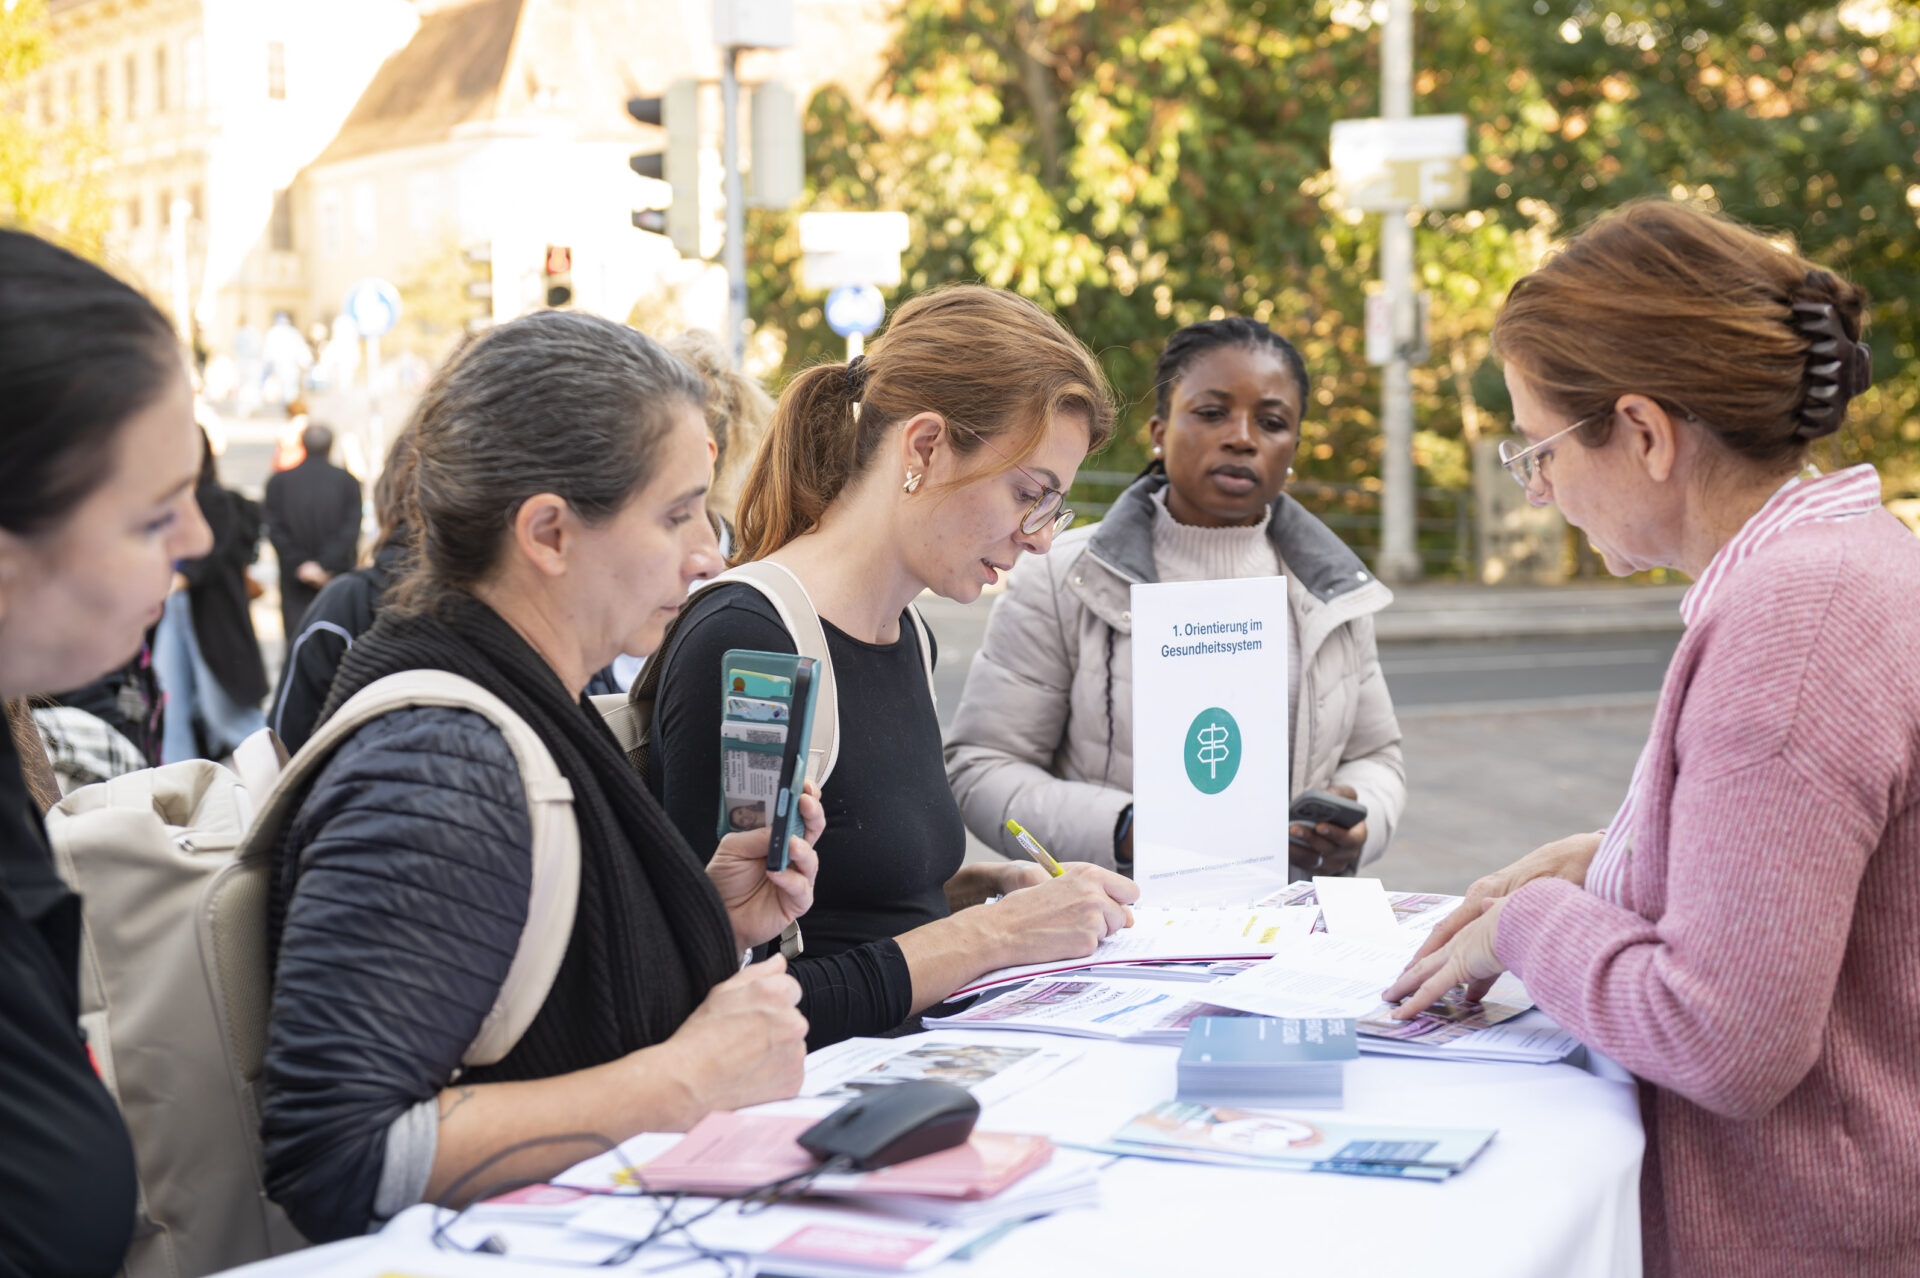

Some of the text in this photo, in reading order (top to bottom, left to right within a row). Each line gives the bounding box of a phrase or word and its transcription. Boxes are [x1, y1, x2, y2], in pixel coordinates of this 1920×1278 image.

[1173, 619, 1262, 637] 1. Orientierung im
[1161, 640, 1262, 658] Gesundheitssystem
